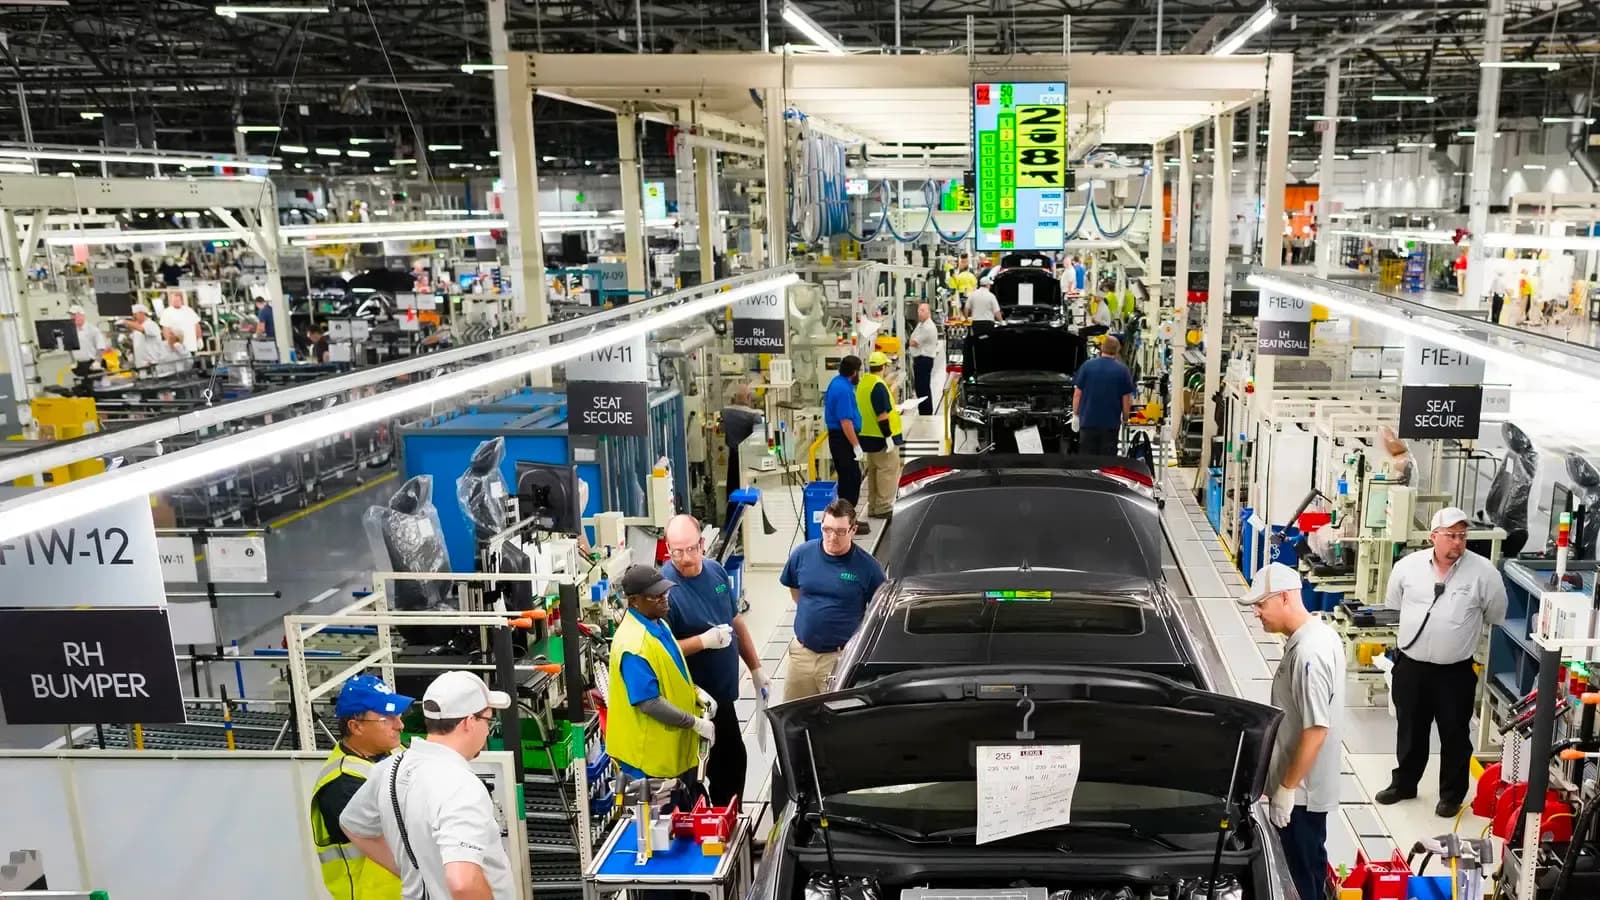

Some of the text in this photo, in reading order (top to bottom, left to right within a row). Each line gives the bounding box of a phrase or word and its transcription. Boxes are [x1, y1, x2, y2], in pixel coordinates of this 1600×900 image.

[1000, 85, 1013, 97] 50
[1042, 203, 1060, 214] 457
[1269, 296, 1304, 309] F1E-10
[752, 328, 765, 337] RH
[1278, 330, 1290, 339] LH
[735, 337, 784, 347] SEAT INSTALL
[1259, 339, 1308, 349] SEAT INSTALL
[592, 396, 622, 409] SEAT
[1425, 400, 1457, 412] SEAT
[583, 411, 633, 424] SECURE
[1414, 415, 1465, 427] SECURE
[63, 642, 105, 667] RH
[30, 673, 150, 698] BUMPER
[995, 752, 1012, 761] 235
